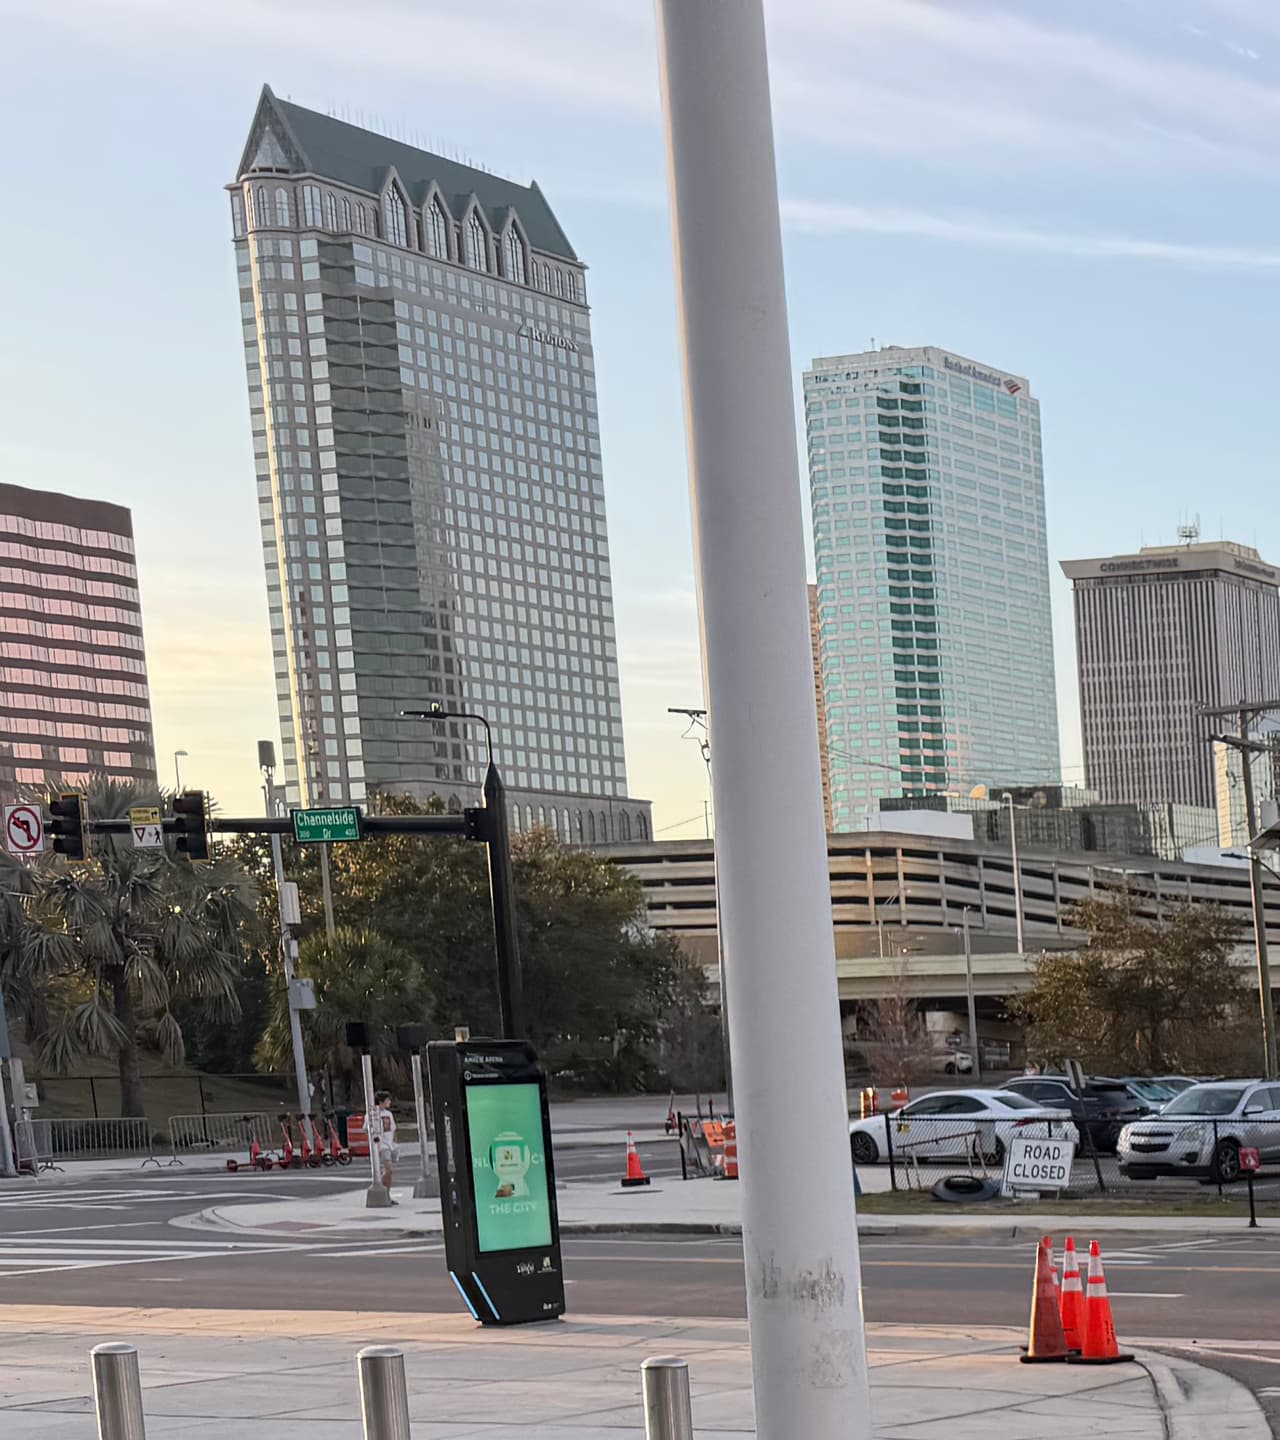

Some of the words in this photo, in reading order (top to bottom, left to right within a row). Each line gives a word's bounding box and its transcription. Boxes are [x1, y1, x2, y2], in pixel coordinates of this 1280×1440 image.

[297, 811, 355, 826] Channelside
[322, 828, 332, 839] Dr
[1024, 1144, 1061, 1160] ROAD
[1013, 1163, 1066, 1180] CLOSED
[490, 1203, 510, 1214] THE
[513, 1201, 537, 1213] CITY
